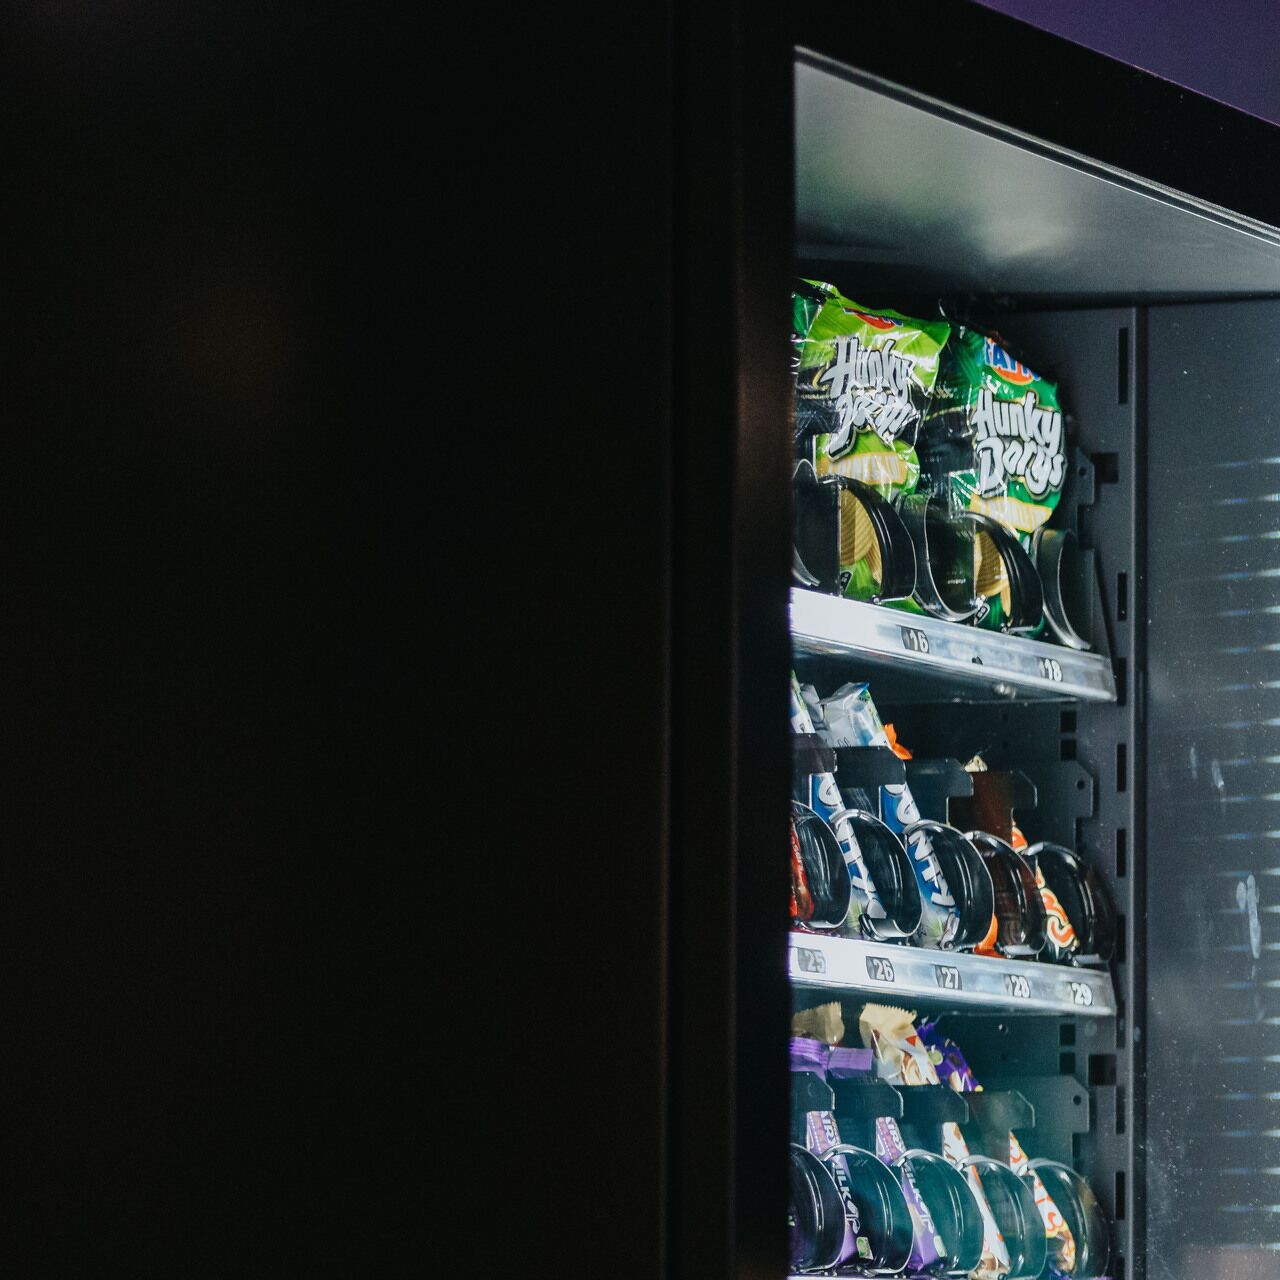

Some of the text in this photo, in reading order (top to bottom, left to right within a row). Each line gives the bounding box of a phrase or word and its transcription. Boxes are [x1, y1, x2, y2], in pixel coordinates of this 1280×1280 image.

[819, 336, 914, 406] Hunky
[971, 388, 1062, 457] Hunky
[976, 436, 1066, 497] Dorys
[910, 629, 1063, 682] 16 18
[805, 950, 1094, 1006] 25 26 27 28 29
